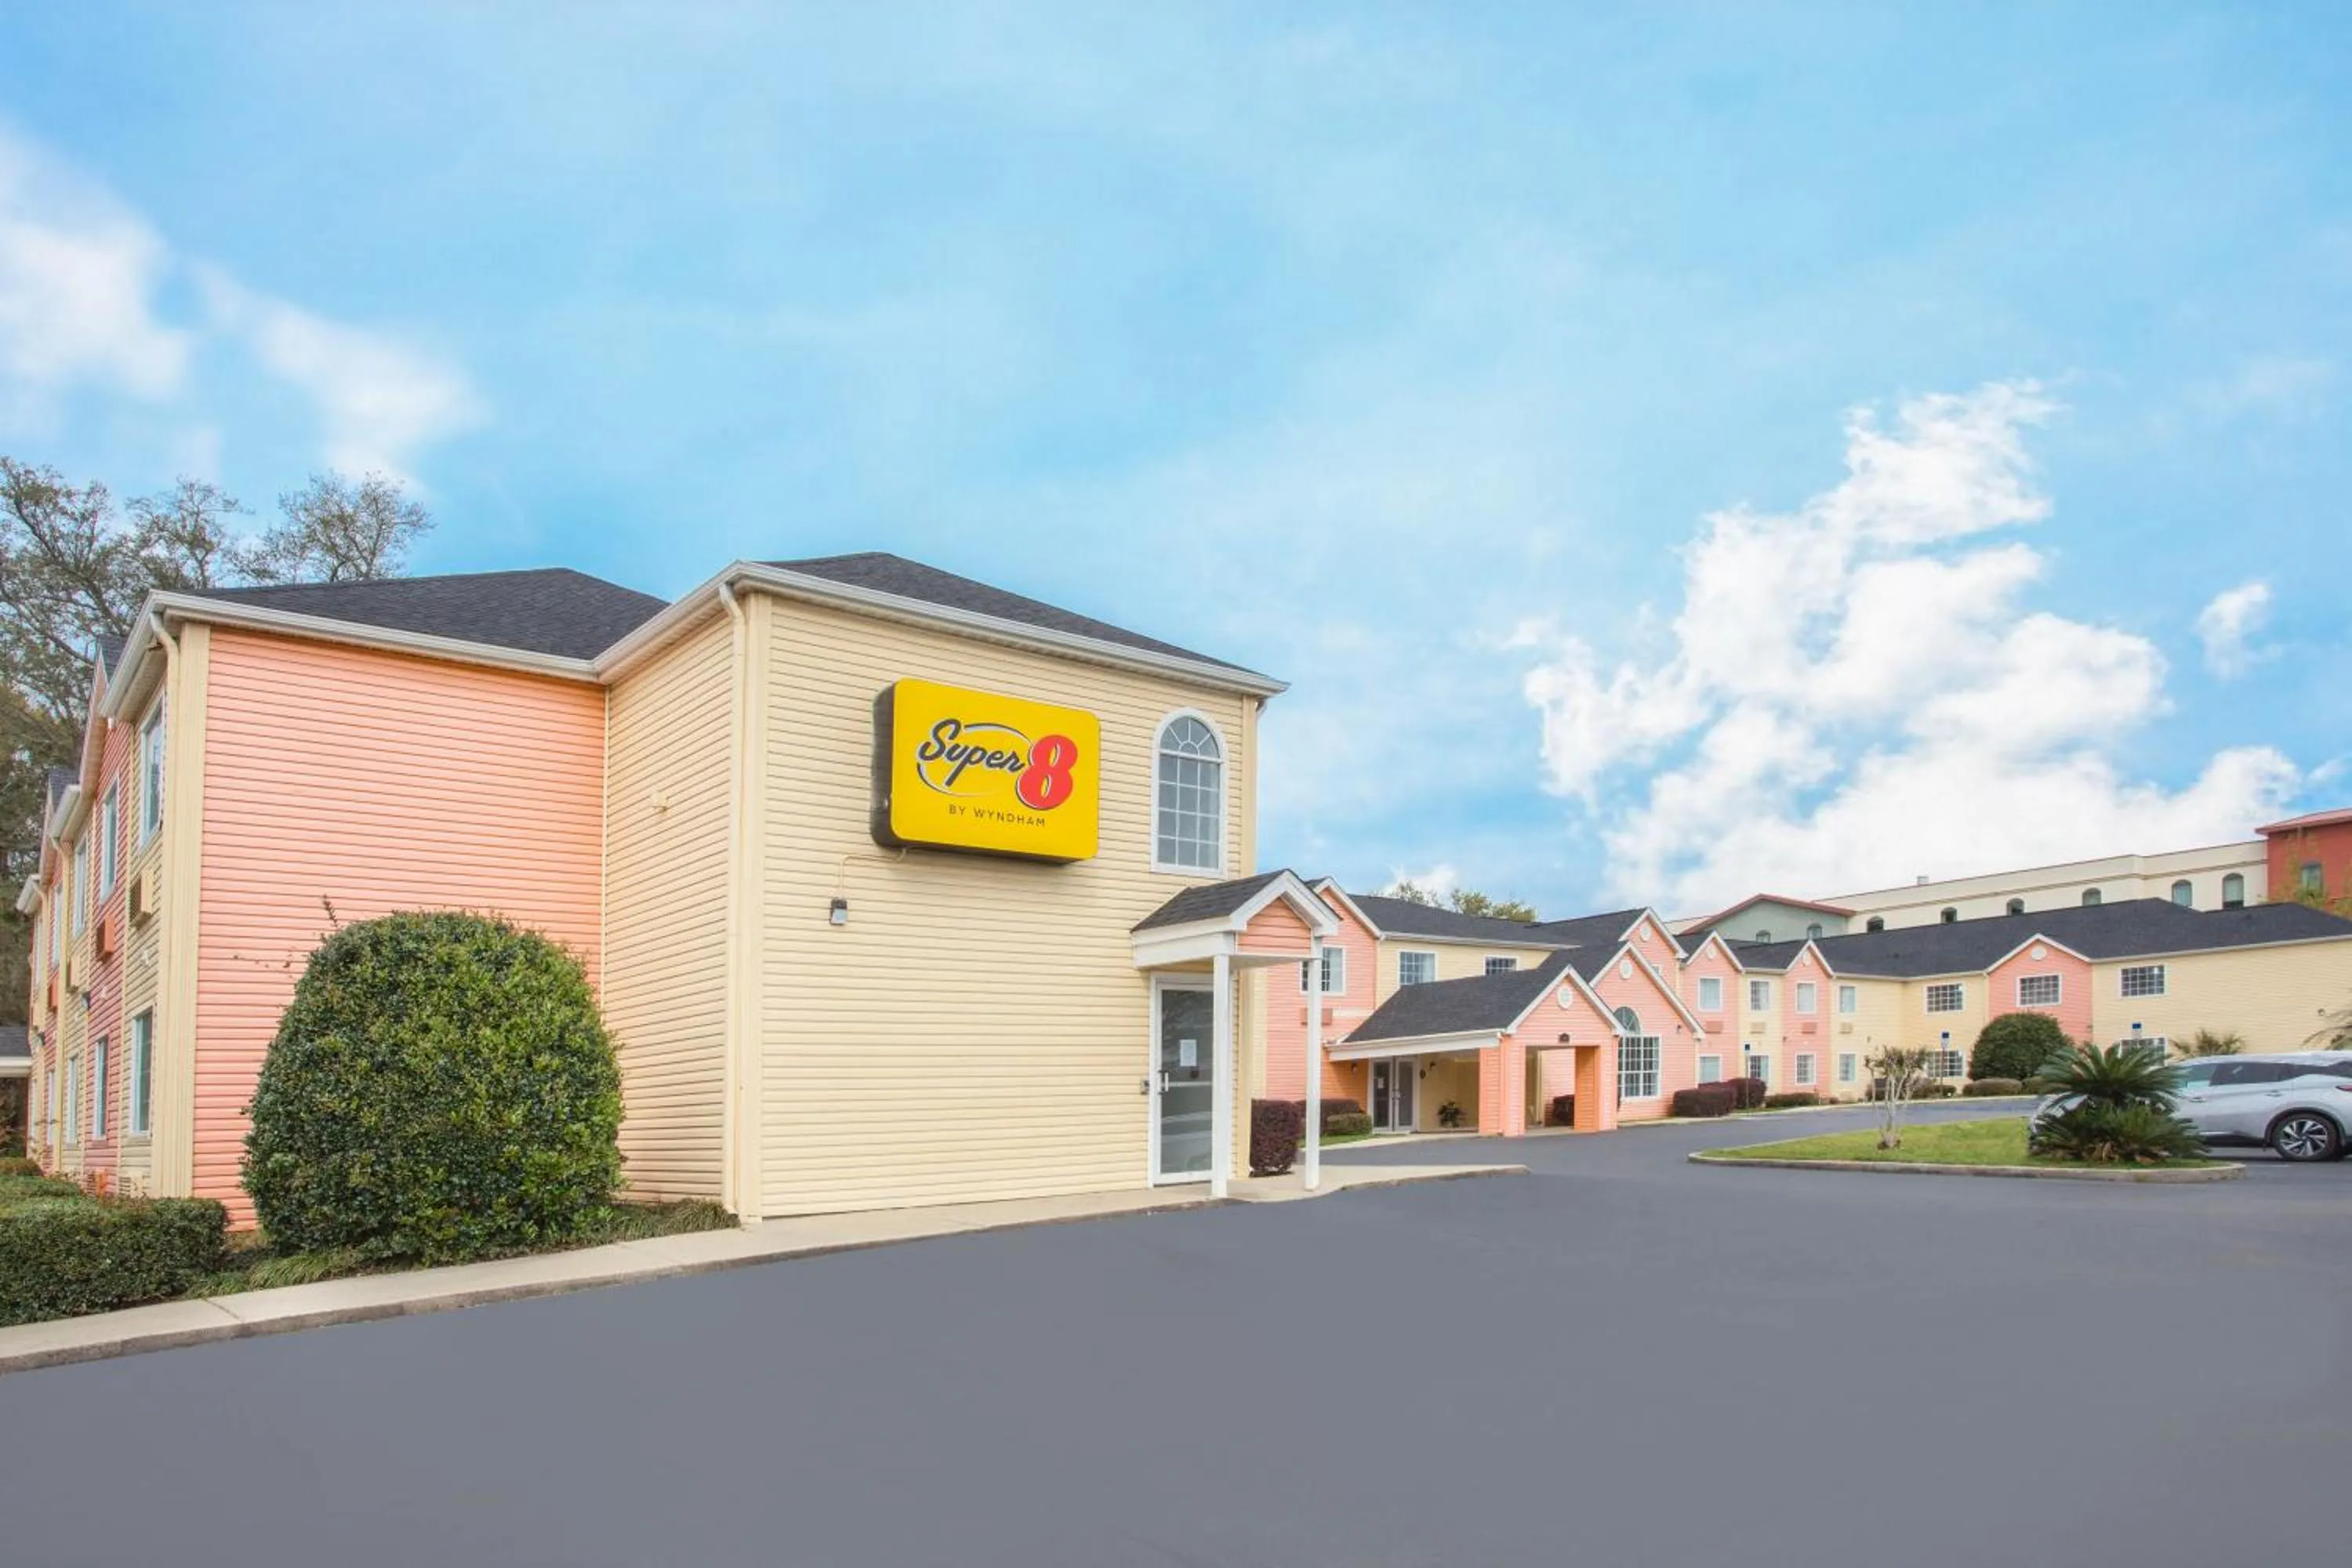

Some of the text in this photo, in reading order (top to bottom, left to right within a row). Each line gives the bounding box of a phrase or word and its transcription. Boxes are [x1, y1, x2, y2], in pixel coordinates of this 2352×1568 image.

[917, 717, 1078, 811] Super 8
[949, 804, 1046, 826] BY WYNDHAM
